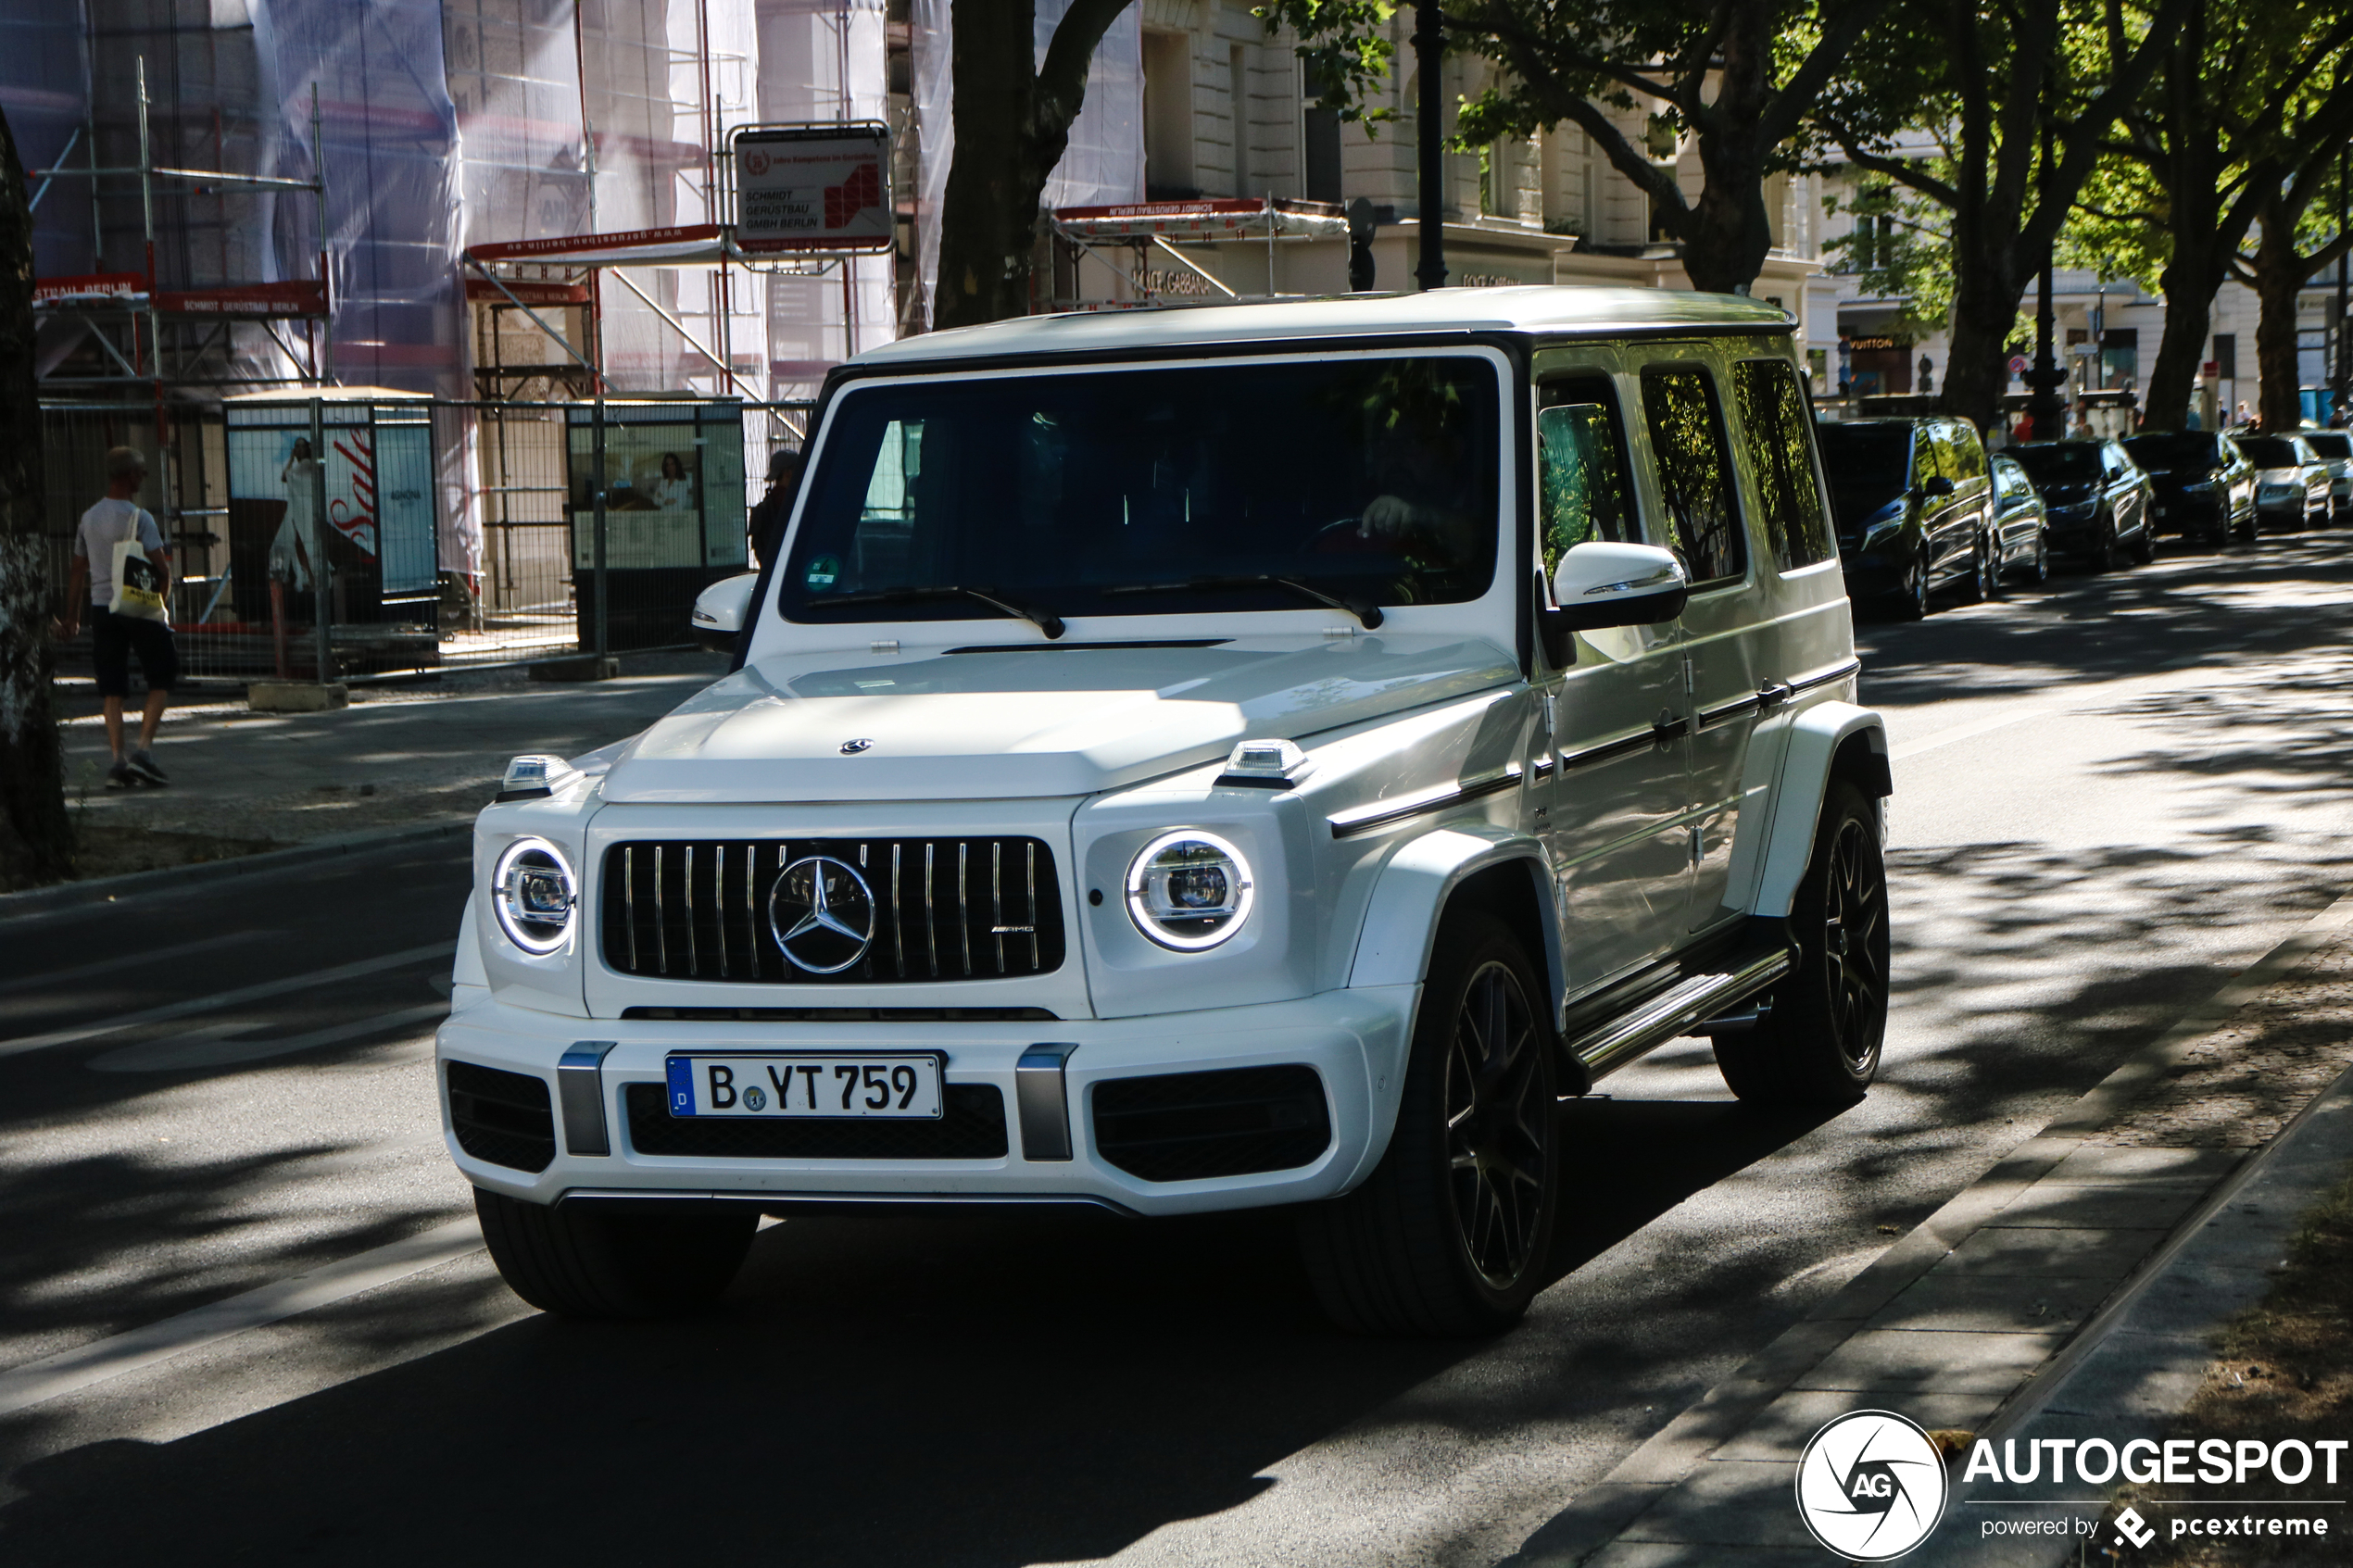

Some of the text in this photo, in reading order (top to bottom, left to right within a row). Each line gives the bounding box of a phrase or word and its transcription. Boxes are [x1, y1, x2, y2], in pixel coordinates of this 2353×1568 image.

[773, 156, 791, 165] Jahre
[793, 155, 831, 165] Kompetenz
[745, 190, 793, 202] SCHMIDT
[746, 204, 810, 216] GERÜSTBAU
[1108, 203, 1213, 217] SCHMIDT GERÜSTBAU BERLIN
[746, 217, 818, 230] GMBH BERLIN
[84, 281, 132, 295] BERLIN
[1167, 271, 1209, 295] GABBANA
[183, 299, 299, 312] SCHMIDT GERÜSTBAU BERLIN
[1850, 337, 1894, 350] VUITTON
[708, 1065, 917, 1110] B YT 759
[677, 1093, 687, 1106] D
